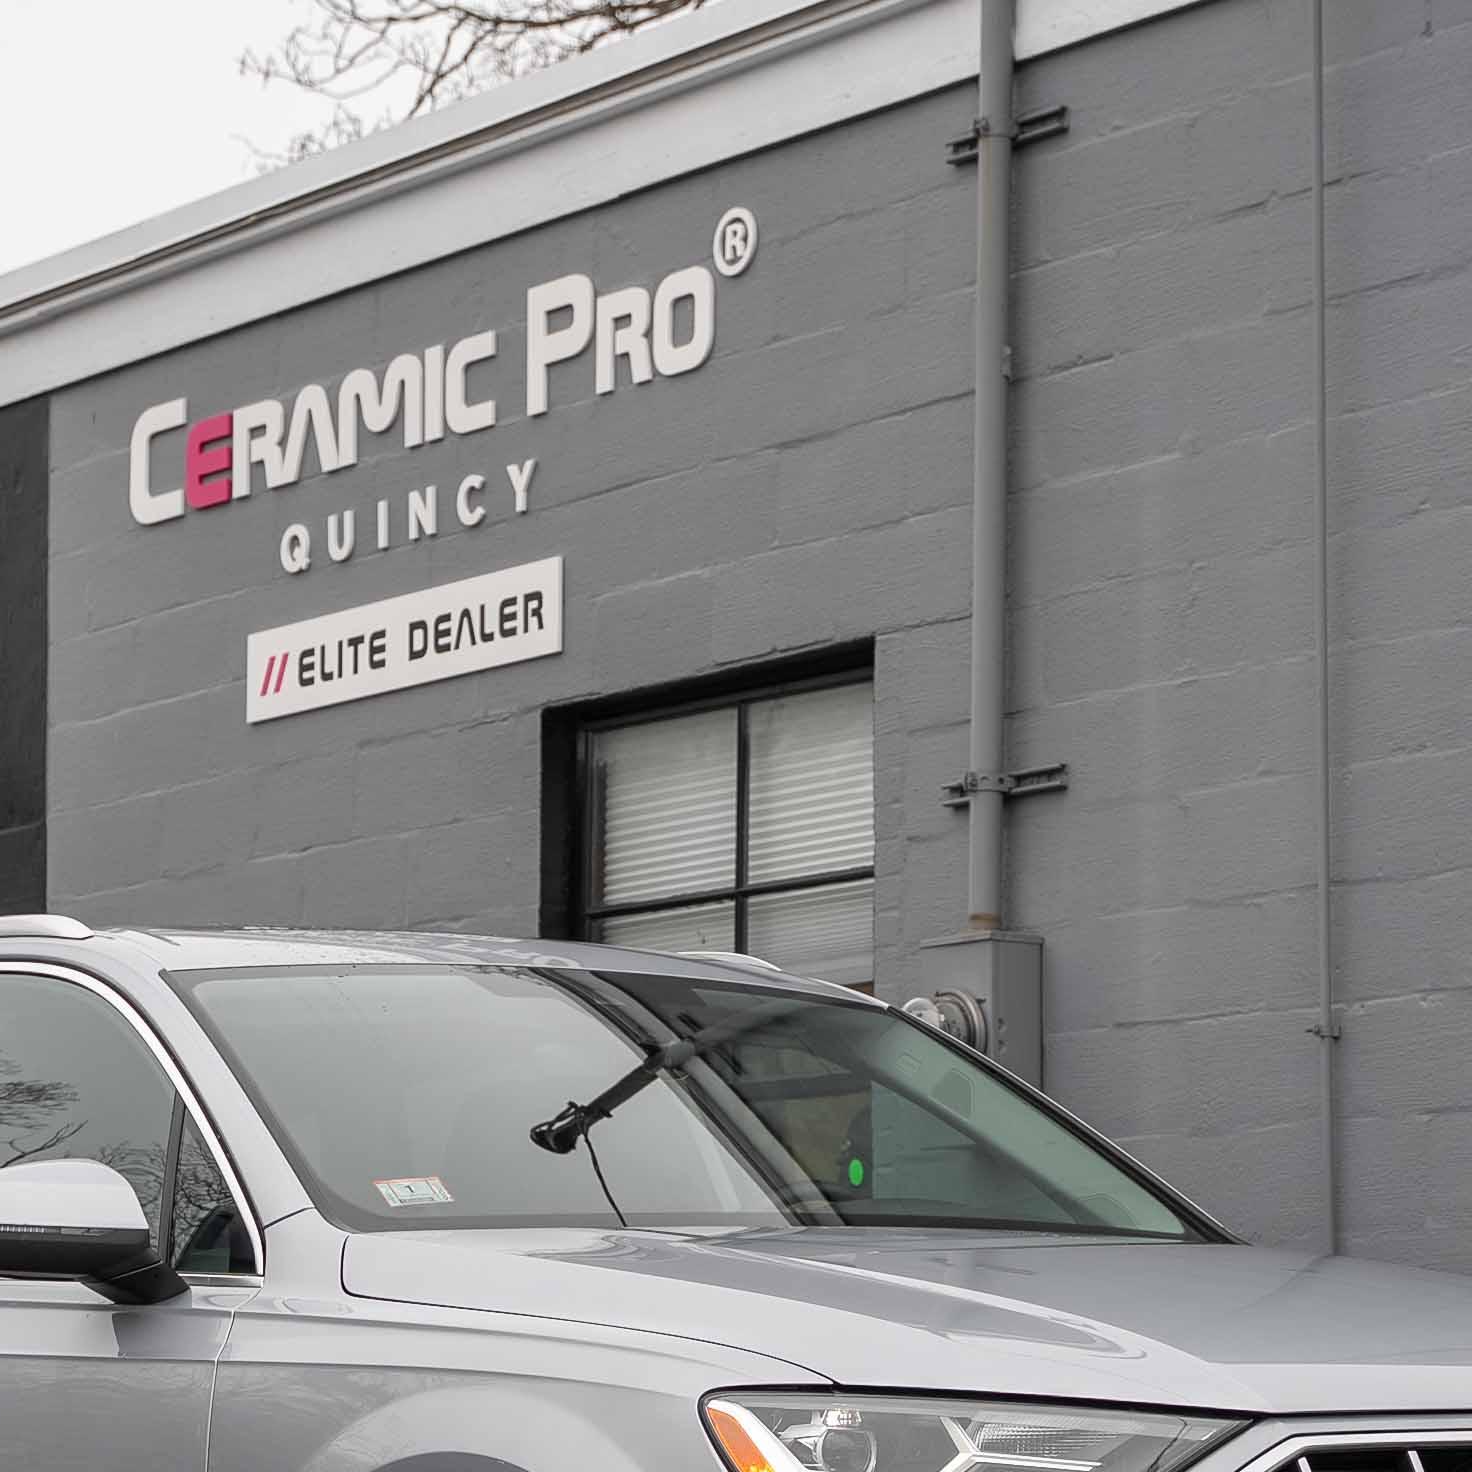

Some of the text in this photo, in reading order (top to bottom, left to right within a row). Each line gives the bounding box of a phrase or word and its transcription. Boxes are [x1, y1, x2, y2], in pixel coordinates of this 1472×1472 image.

[128, 329, 497, 526] CERAMIC
[278, 457, 537, 574] QUINCY
[407, 589, 545, 661] DEALER
